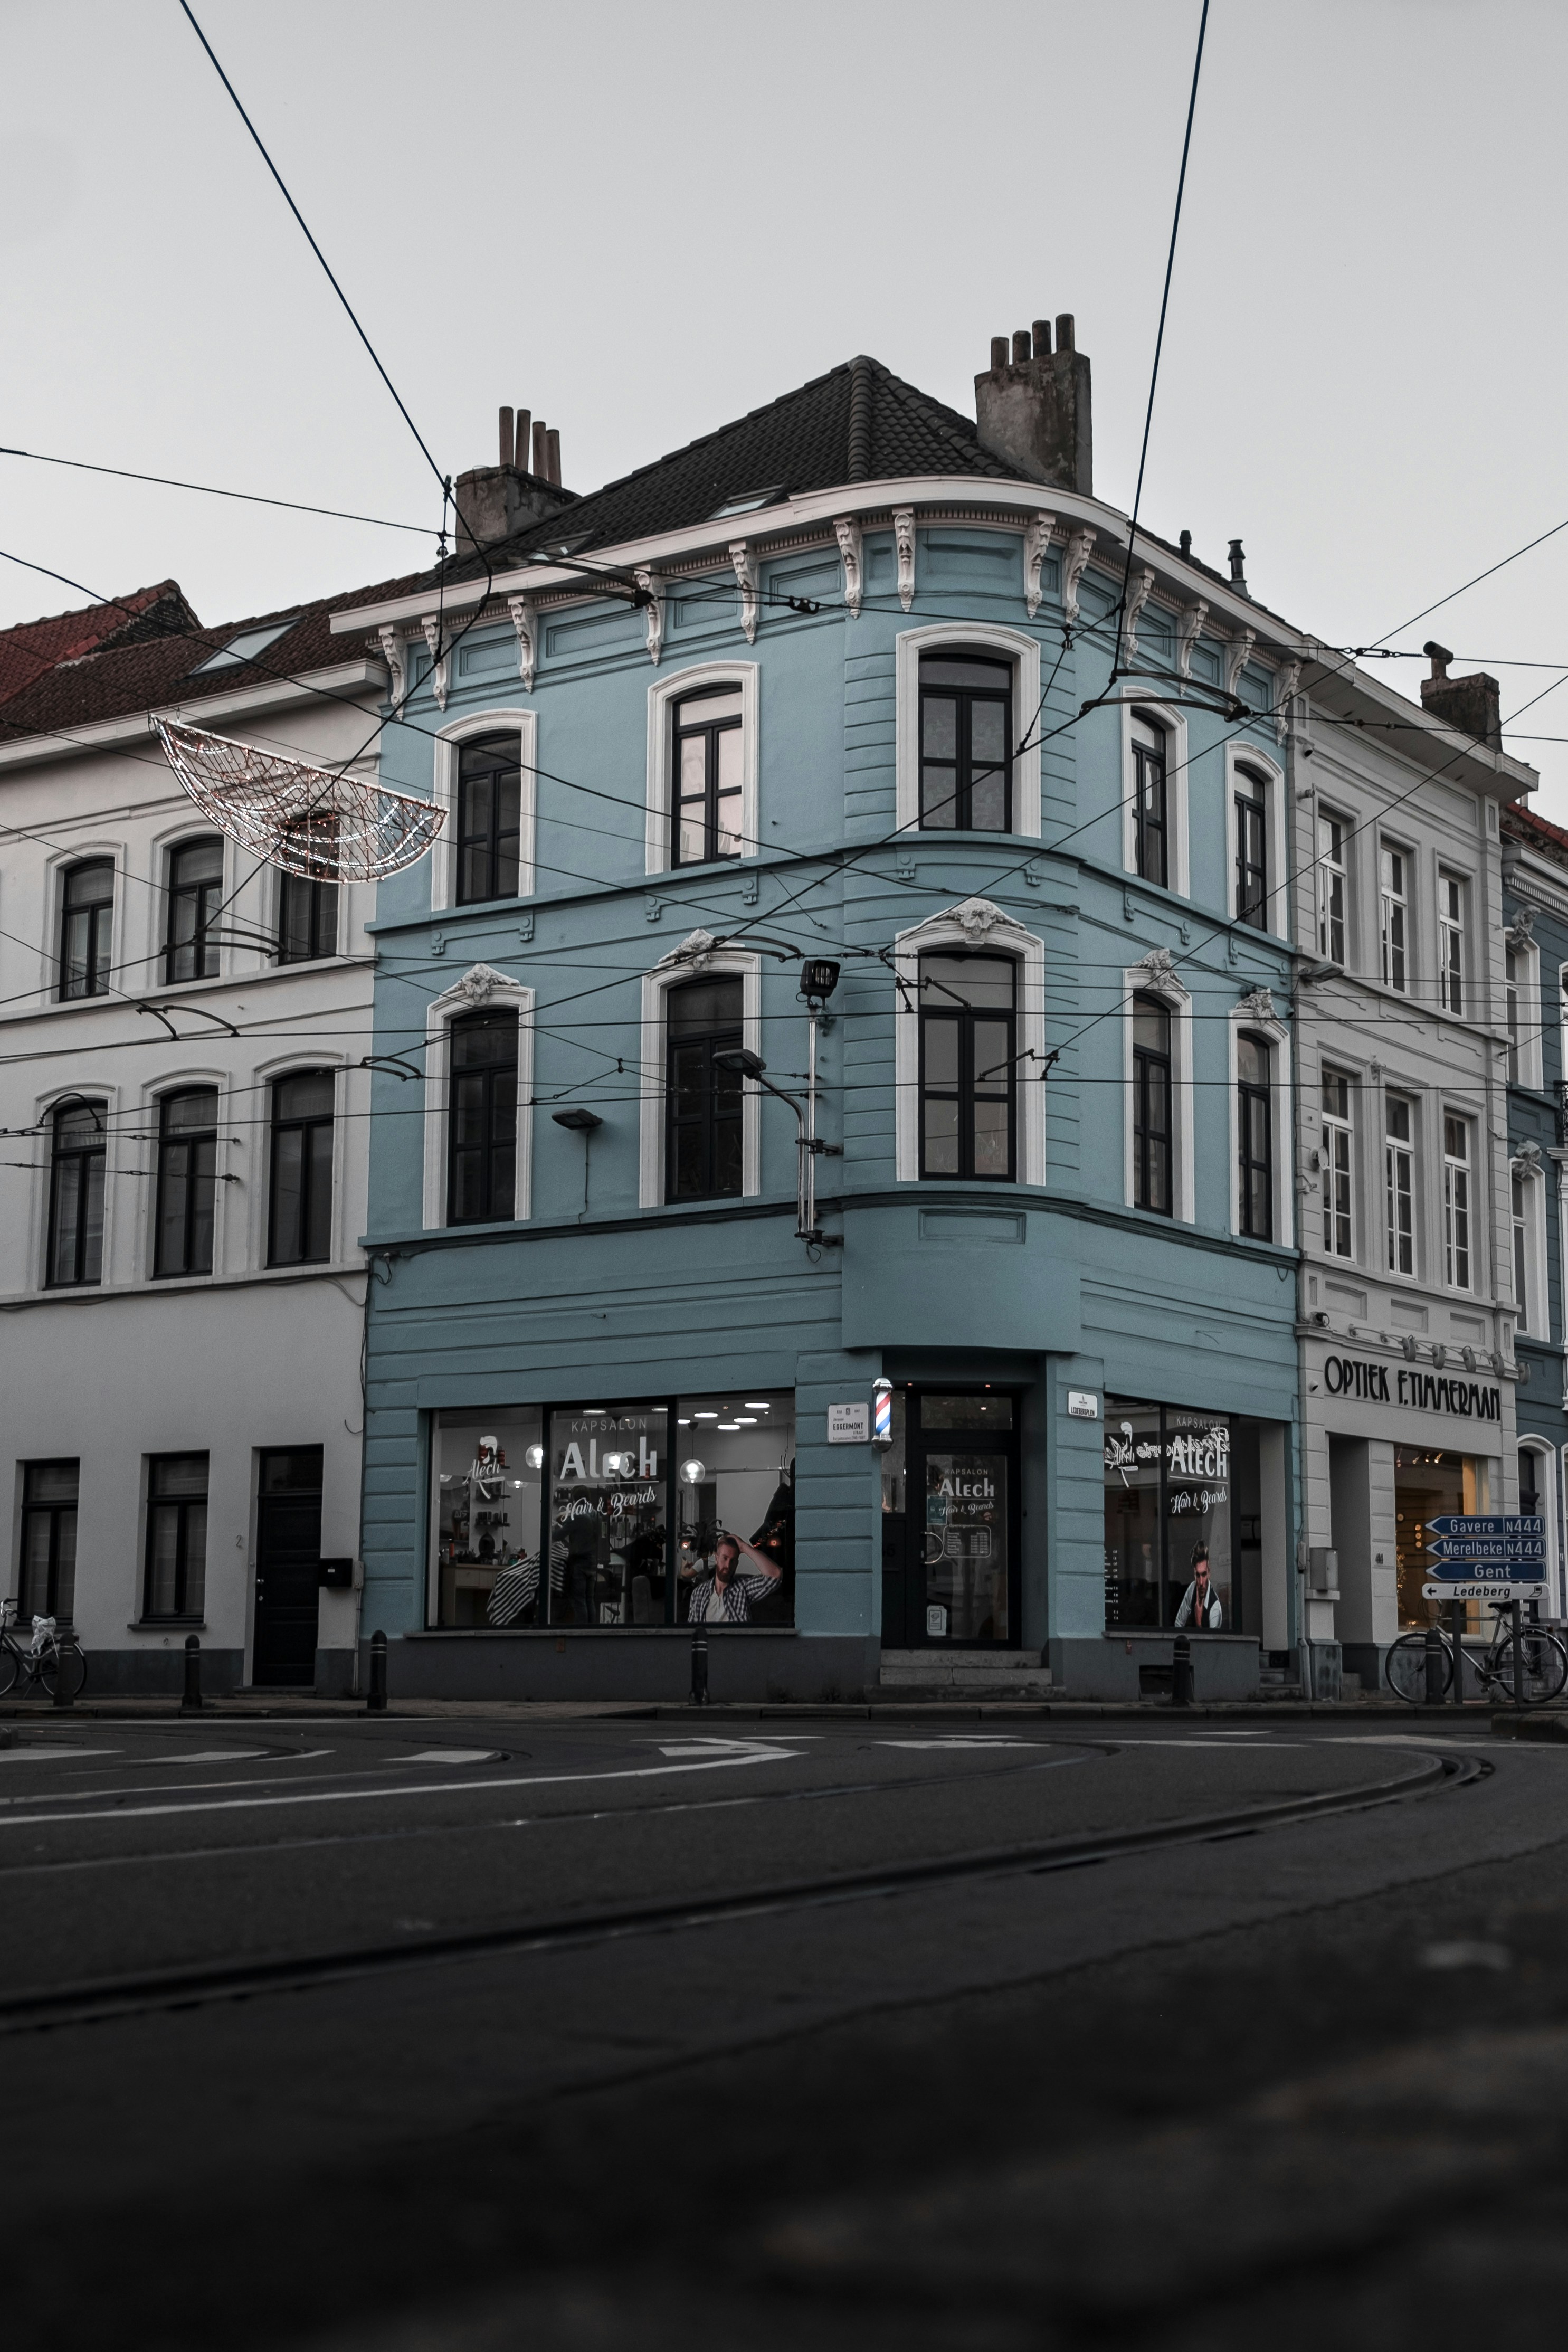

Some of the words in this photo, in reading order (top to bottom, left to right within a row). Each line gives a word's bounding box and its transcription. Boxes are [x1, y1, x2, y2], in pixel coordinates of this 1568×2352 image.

[1324, 1355, 1390, 1402] OPTIEK
[571, 1418, 648, 1433] KAPSALON
[833, 1422, 863, 1431] EGGERMONT
[1176, 1415, 1221, 1431] KAPSALON
[559, 1436, 658, 1480] Alech
[1170, 1434, 1228, 1478] Alech
[461, 1457, 501, 1486] Alech
[938, 1477, 995, 1497] Alech
[559, 1496, 594, 1522] Hair
[596, 1496, 607, 1516] &
[608, 1486, 658, 1516] Beards
[1171, 1491, 1192, 1514] Hair
[1193, 1492, 1200, 1511] &
[1201, 1486, 1227, 1513] Beards
[938, 1504, 959, 1516] Hair
[968, 1501, 994, 1515] Beards
[1450, 1519, 1495, 1534] Gavere
[1506, 1518, 1542, 1534] N444
[236, 1534, 242, 1549] 2
[1443, 1541, 1503, 1556] Merelbeke
[1507, 1541, 1542, 1556] N444
[1474, 1564, 1512, 1579] Gent
[1453, 1586, 1512, 1600] Ledeberg
